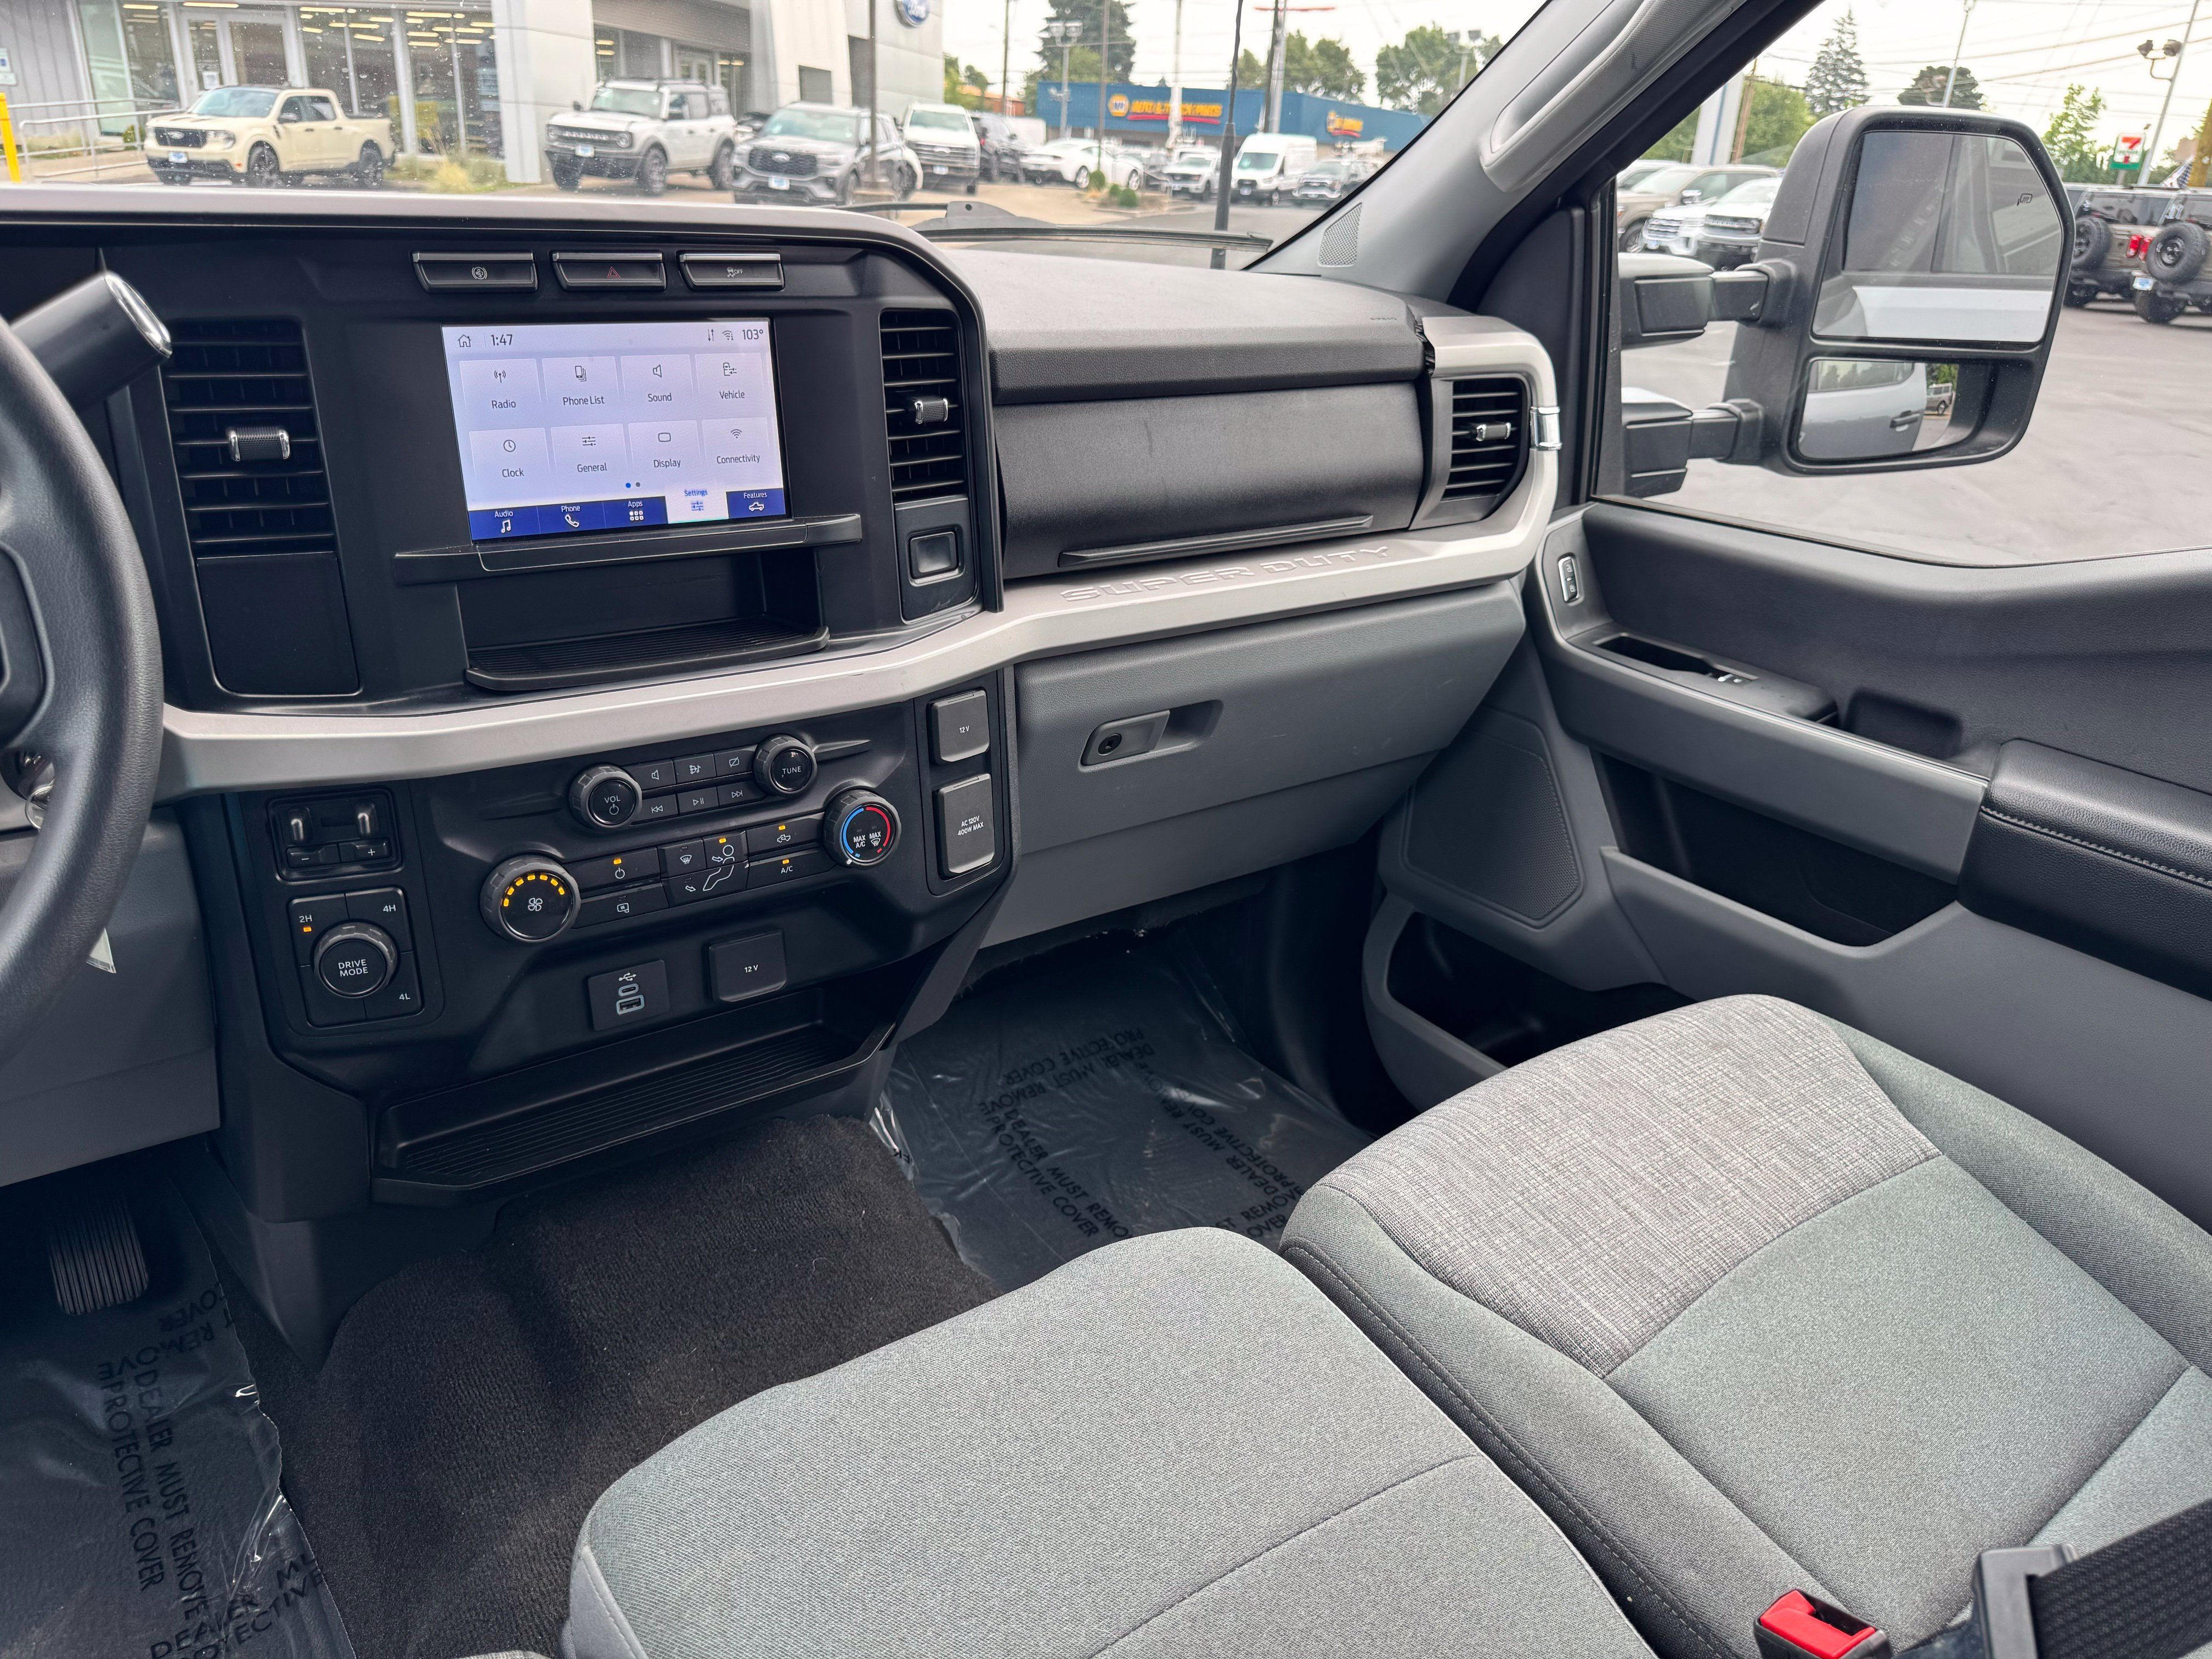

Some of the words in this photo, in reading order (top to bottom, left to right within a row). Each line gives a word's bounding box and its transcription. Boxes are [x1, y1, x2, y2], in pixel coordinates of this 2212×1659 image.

[490, 334, 513, 346] 1:47
[647, 392, 672, 402] Sound
[719, 390, 745, 400] Vehicle
[492, 400, 516, 409] Radio
[562, 396, 588, 406] Phone
[590, 395, 605, 405] List
[653, 458, 681, 469] Display
[716, 454, 761, 465] Connectivity
[501, 467, 524, 477] Clock
[577, 462, 607, 472] General
[684, 489, 708, 498] Settings
[743, 492, 767, 500] Features
[561, 504, 580, 513] Phone
[628, 500, 643, 509] Apps
[494, 509, 514, 518] Audio
[1060, 566, 1255, 601] SUPER
[1260, 545, 1389, 574] DUTY
[782, 766, 802, 775] TUNE
[604, 795, 621, 804] VOL
[968, 815, 980, 825] 120V
[958, 826, 972, 836] 400W
[973, 822, 984, 832] MAX
[853, 835, 866, 843] MAX
[781, 866, 793, 874] A/C
[383, 904, 396, 913] 4H
[299, 915, 312, 923] 2H
[338, 959, 367, 969] DRIVE
[340, 967, 369, 977] MODE
[399, 992, 411, 1001] 4L
[1183, 1122, 1226, 1152] MUST
[1226, 1154, 1279, 1195] DEALER
[1047, 1166, 1090, 1200] MUST
[1087, 1202, 1132, 1239] REMO
[1052, 1196, 1100, 1238] COVER
[1240, 1213, 1289, 1238] OVER
[134, 1369, 173, 1453] DEALER
[100, 1380, 151, 1514] PROTECTIVE
[129, 1517, 165, 1592] COVER
[155, 1461, 190, 1520] MUST
[170, 1527, 208, 1621] REMOVE
